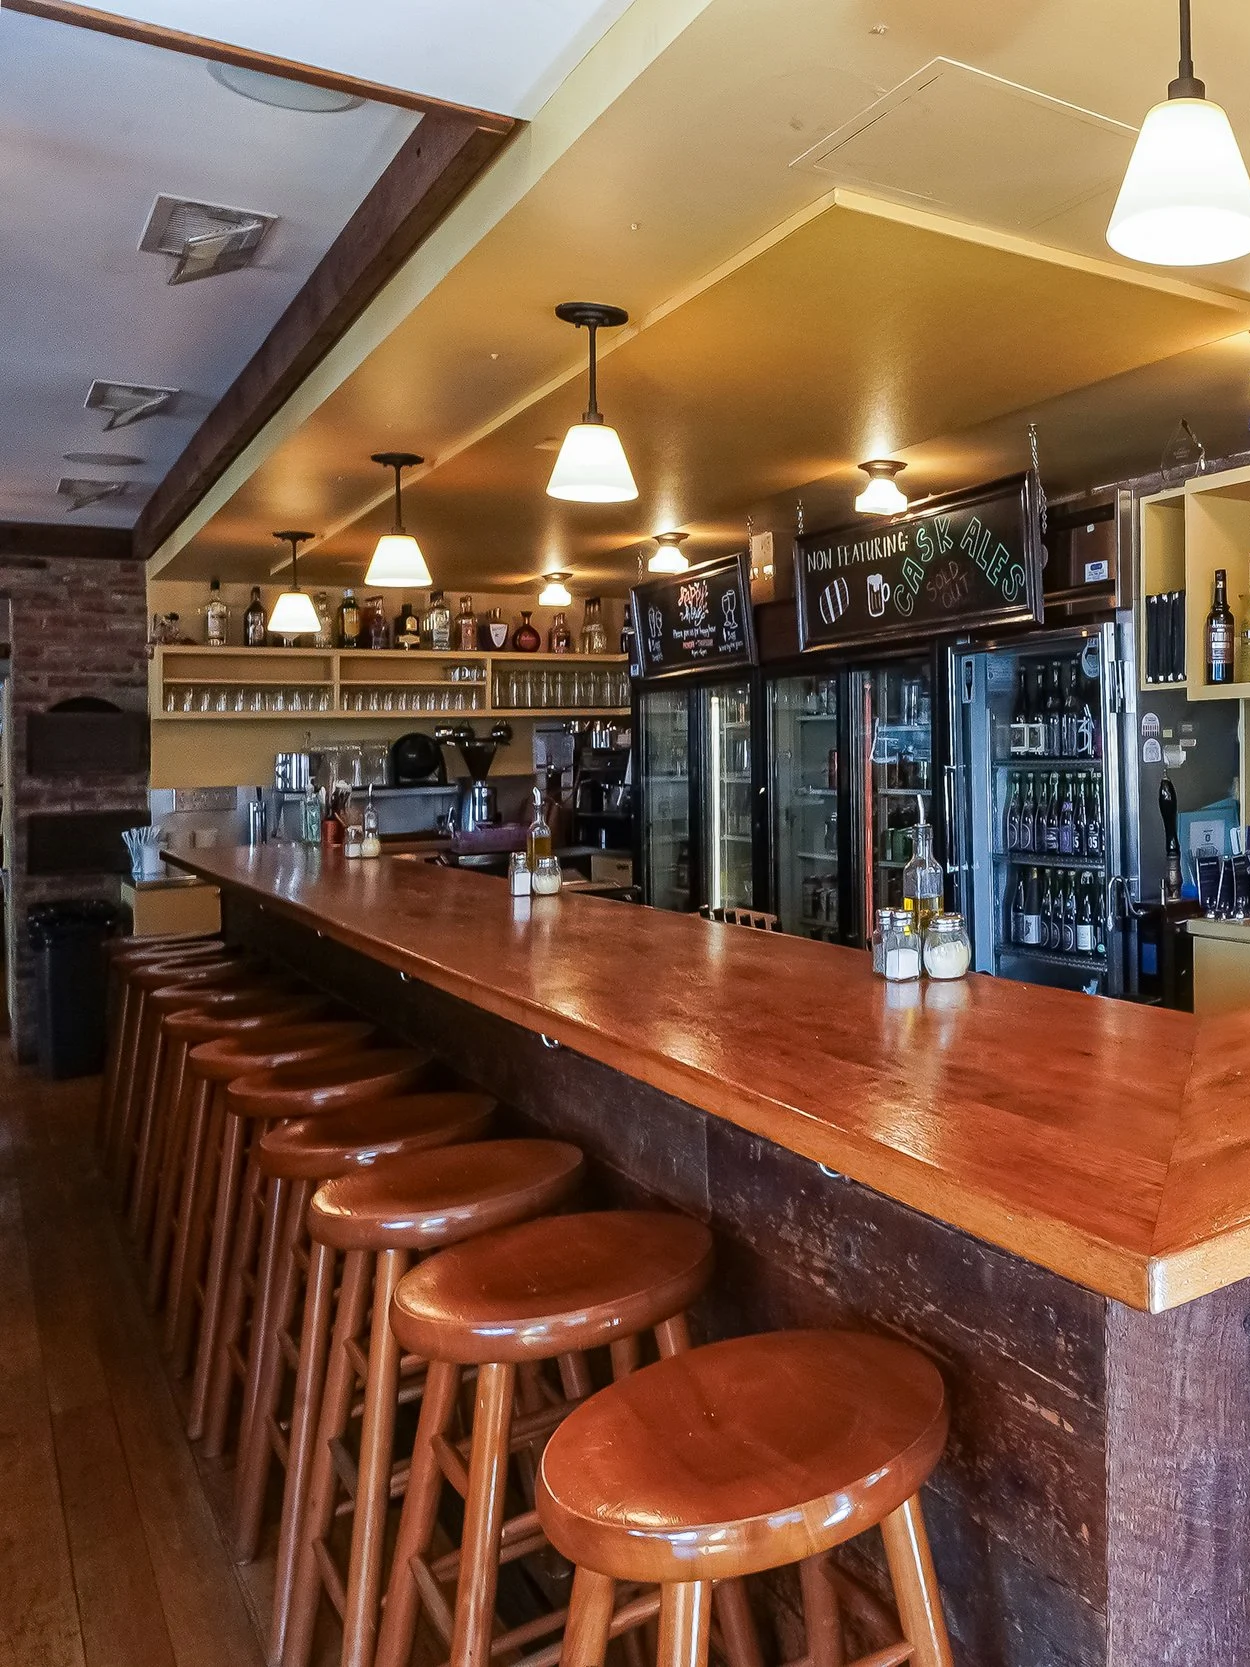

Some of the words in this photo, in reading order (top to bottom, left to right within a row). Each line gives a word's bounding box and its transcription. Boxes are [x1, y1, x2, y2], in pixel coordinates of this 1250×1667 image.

[807, 549, 832, 573] NOW
[837, 532, 909, 567] FEATURING:
[894, 516, 954, 617] CASK
[960, 516, 1025, 602] ALES
[926, 560, 959, 602] SOLD
[941, 571, 969, 609] OUT
